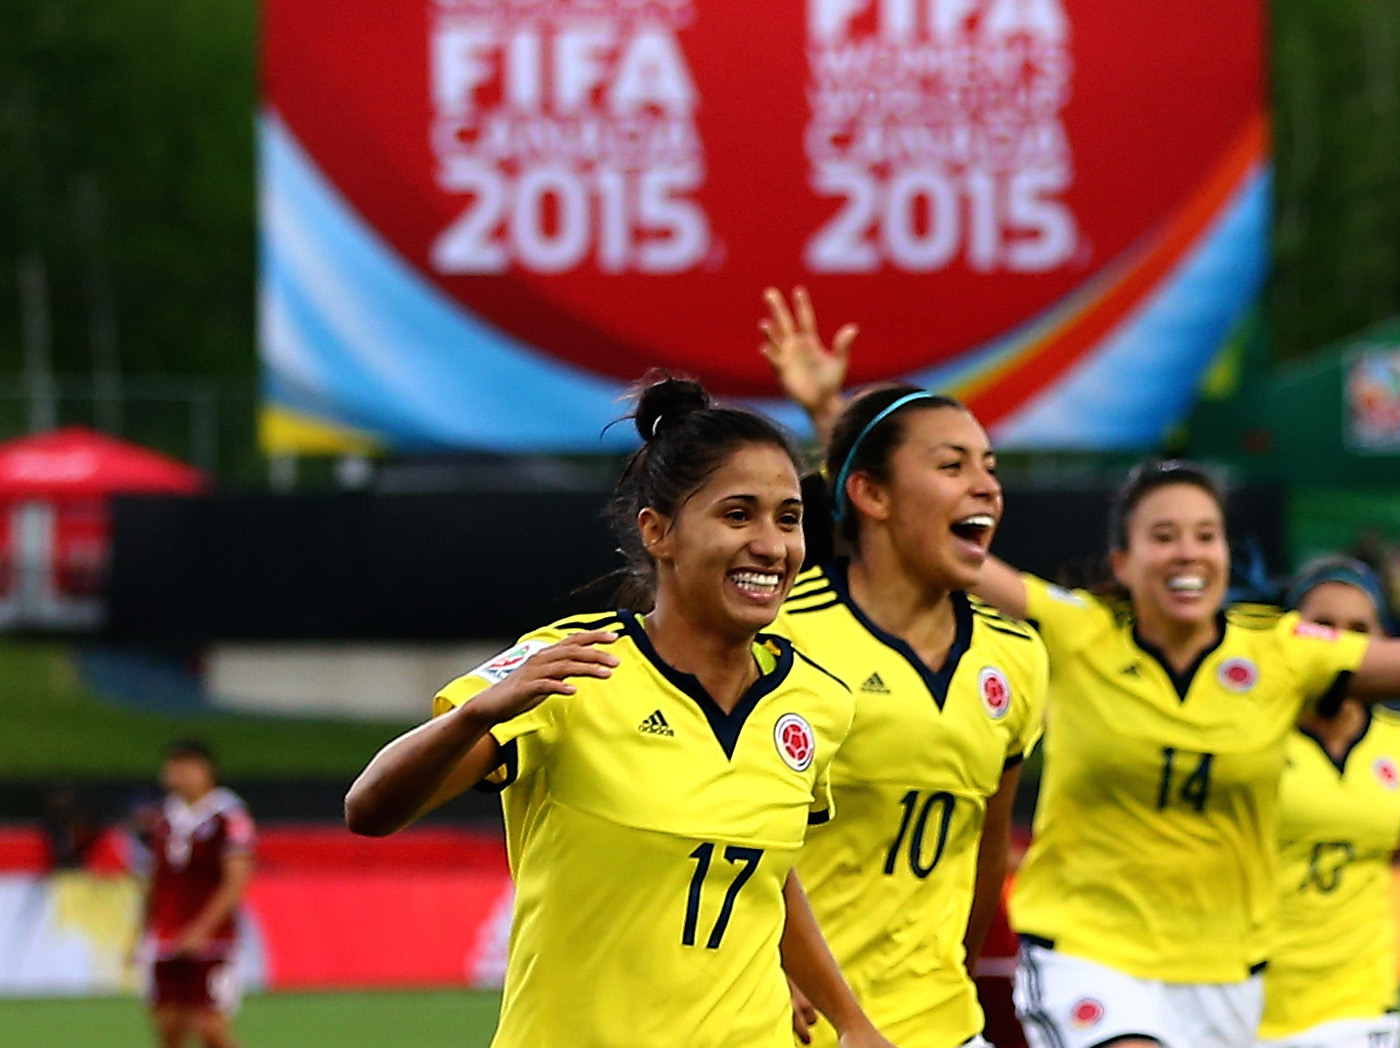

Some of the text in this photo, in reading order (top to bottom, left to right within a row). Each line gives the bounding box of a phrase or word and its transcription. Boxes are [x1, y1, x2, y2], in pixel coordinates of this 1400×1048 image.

[433, 27, 698, 116] FIFA
[432, 118, 701, 165] CANADA
[806, 118, 1068, 166] CANADA
[433, 163, 709, 275] 2015
[806, 163, 1081, 275] 2015
[1157, 746, 1214, 813] 14
[884, 790, 956, 879] 10
[682, 842, 764, 949] 17
